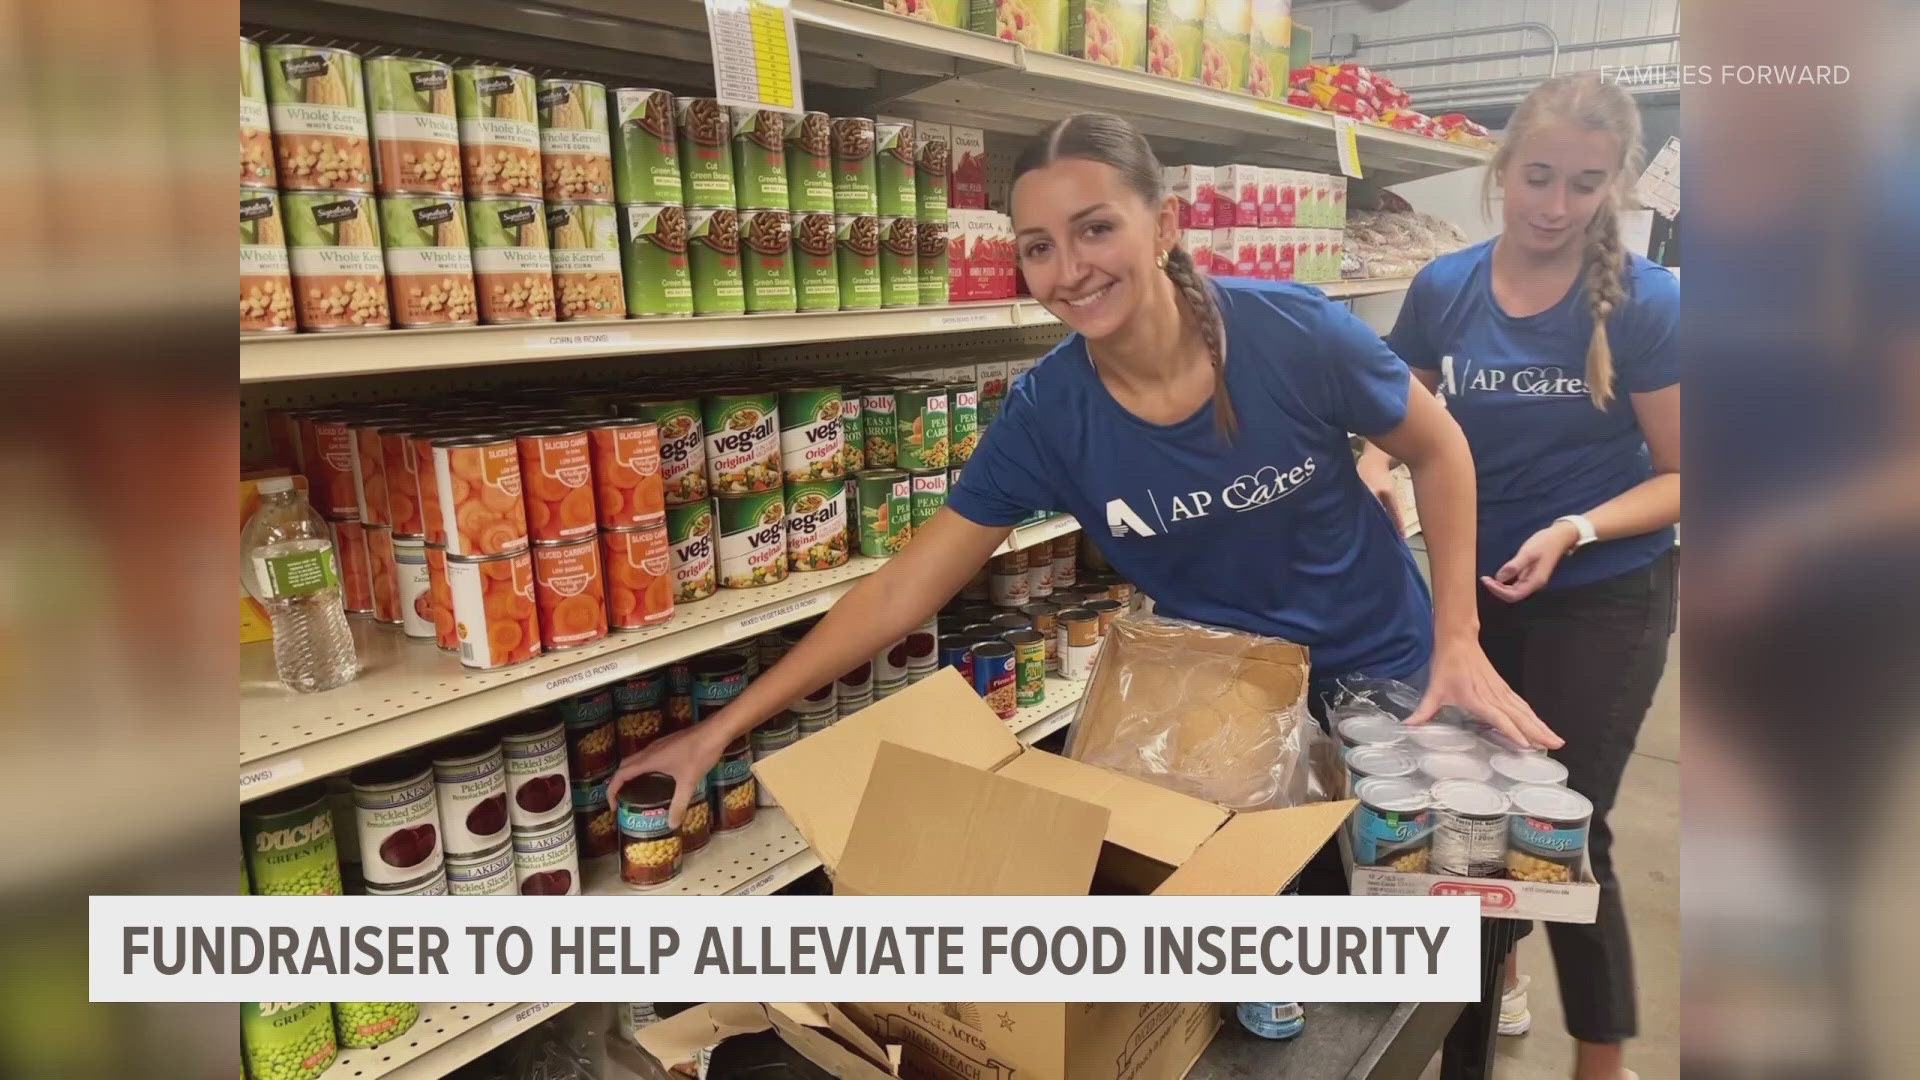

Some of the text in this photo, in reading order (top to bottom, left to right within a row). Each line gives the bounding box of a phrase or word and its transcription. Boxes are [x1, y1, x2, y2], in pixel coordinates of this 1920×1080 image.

[287, 108, 329, 123] Whole
[706, 162, 718, 170] Cut
[690, 171, 712, 180] Green
[320, 251, 360, 262] Whole
[420, 251, 455, 263] Whole
[504, 251, 537, 262] Whole
[572, 253, 604, 263] Kernel
[768, 269, 779, 277] Cut
[816, 269, 827, 277] Cut
[754, 279, 774, 287] Green
[549, 336, 573, 345] CORN
[1470, 369, 1505, 391] AP
[715, 453, 755, 471] Original
[915, 476, 945, 491] Dolly
[1170, 456, 1317, 523] AP Cares
[917, 498, 938, 507] PEAS
[740, 616, 759, 628] MIXED
[760, 605, 794, 622] VEGETABLES
[546, 672, 583, 690] CARROTS
[592, 662, 618, 675] ROWS)
[511, 760, 541, 770] Pickled
[461, 779, 492, 793] Pickled
[374, 797, 432, 821] Pickled Sliced
[267, 850, 310, 864] GREEN
[517, 847, 568, 863] Pickled Sliced
[454, 880, 484, 893] Pickled
[487, 872, 507, 886] Sliced
[273, 1006, 317, 1028] GREEN
[515, 1004, 542, 1022] BEETS
[904, 1026, 939, 1056] DICED
[949, 1023, 987, 1051] Acres
